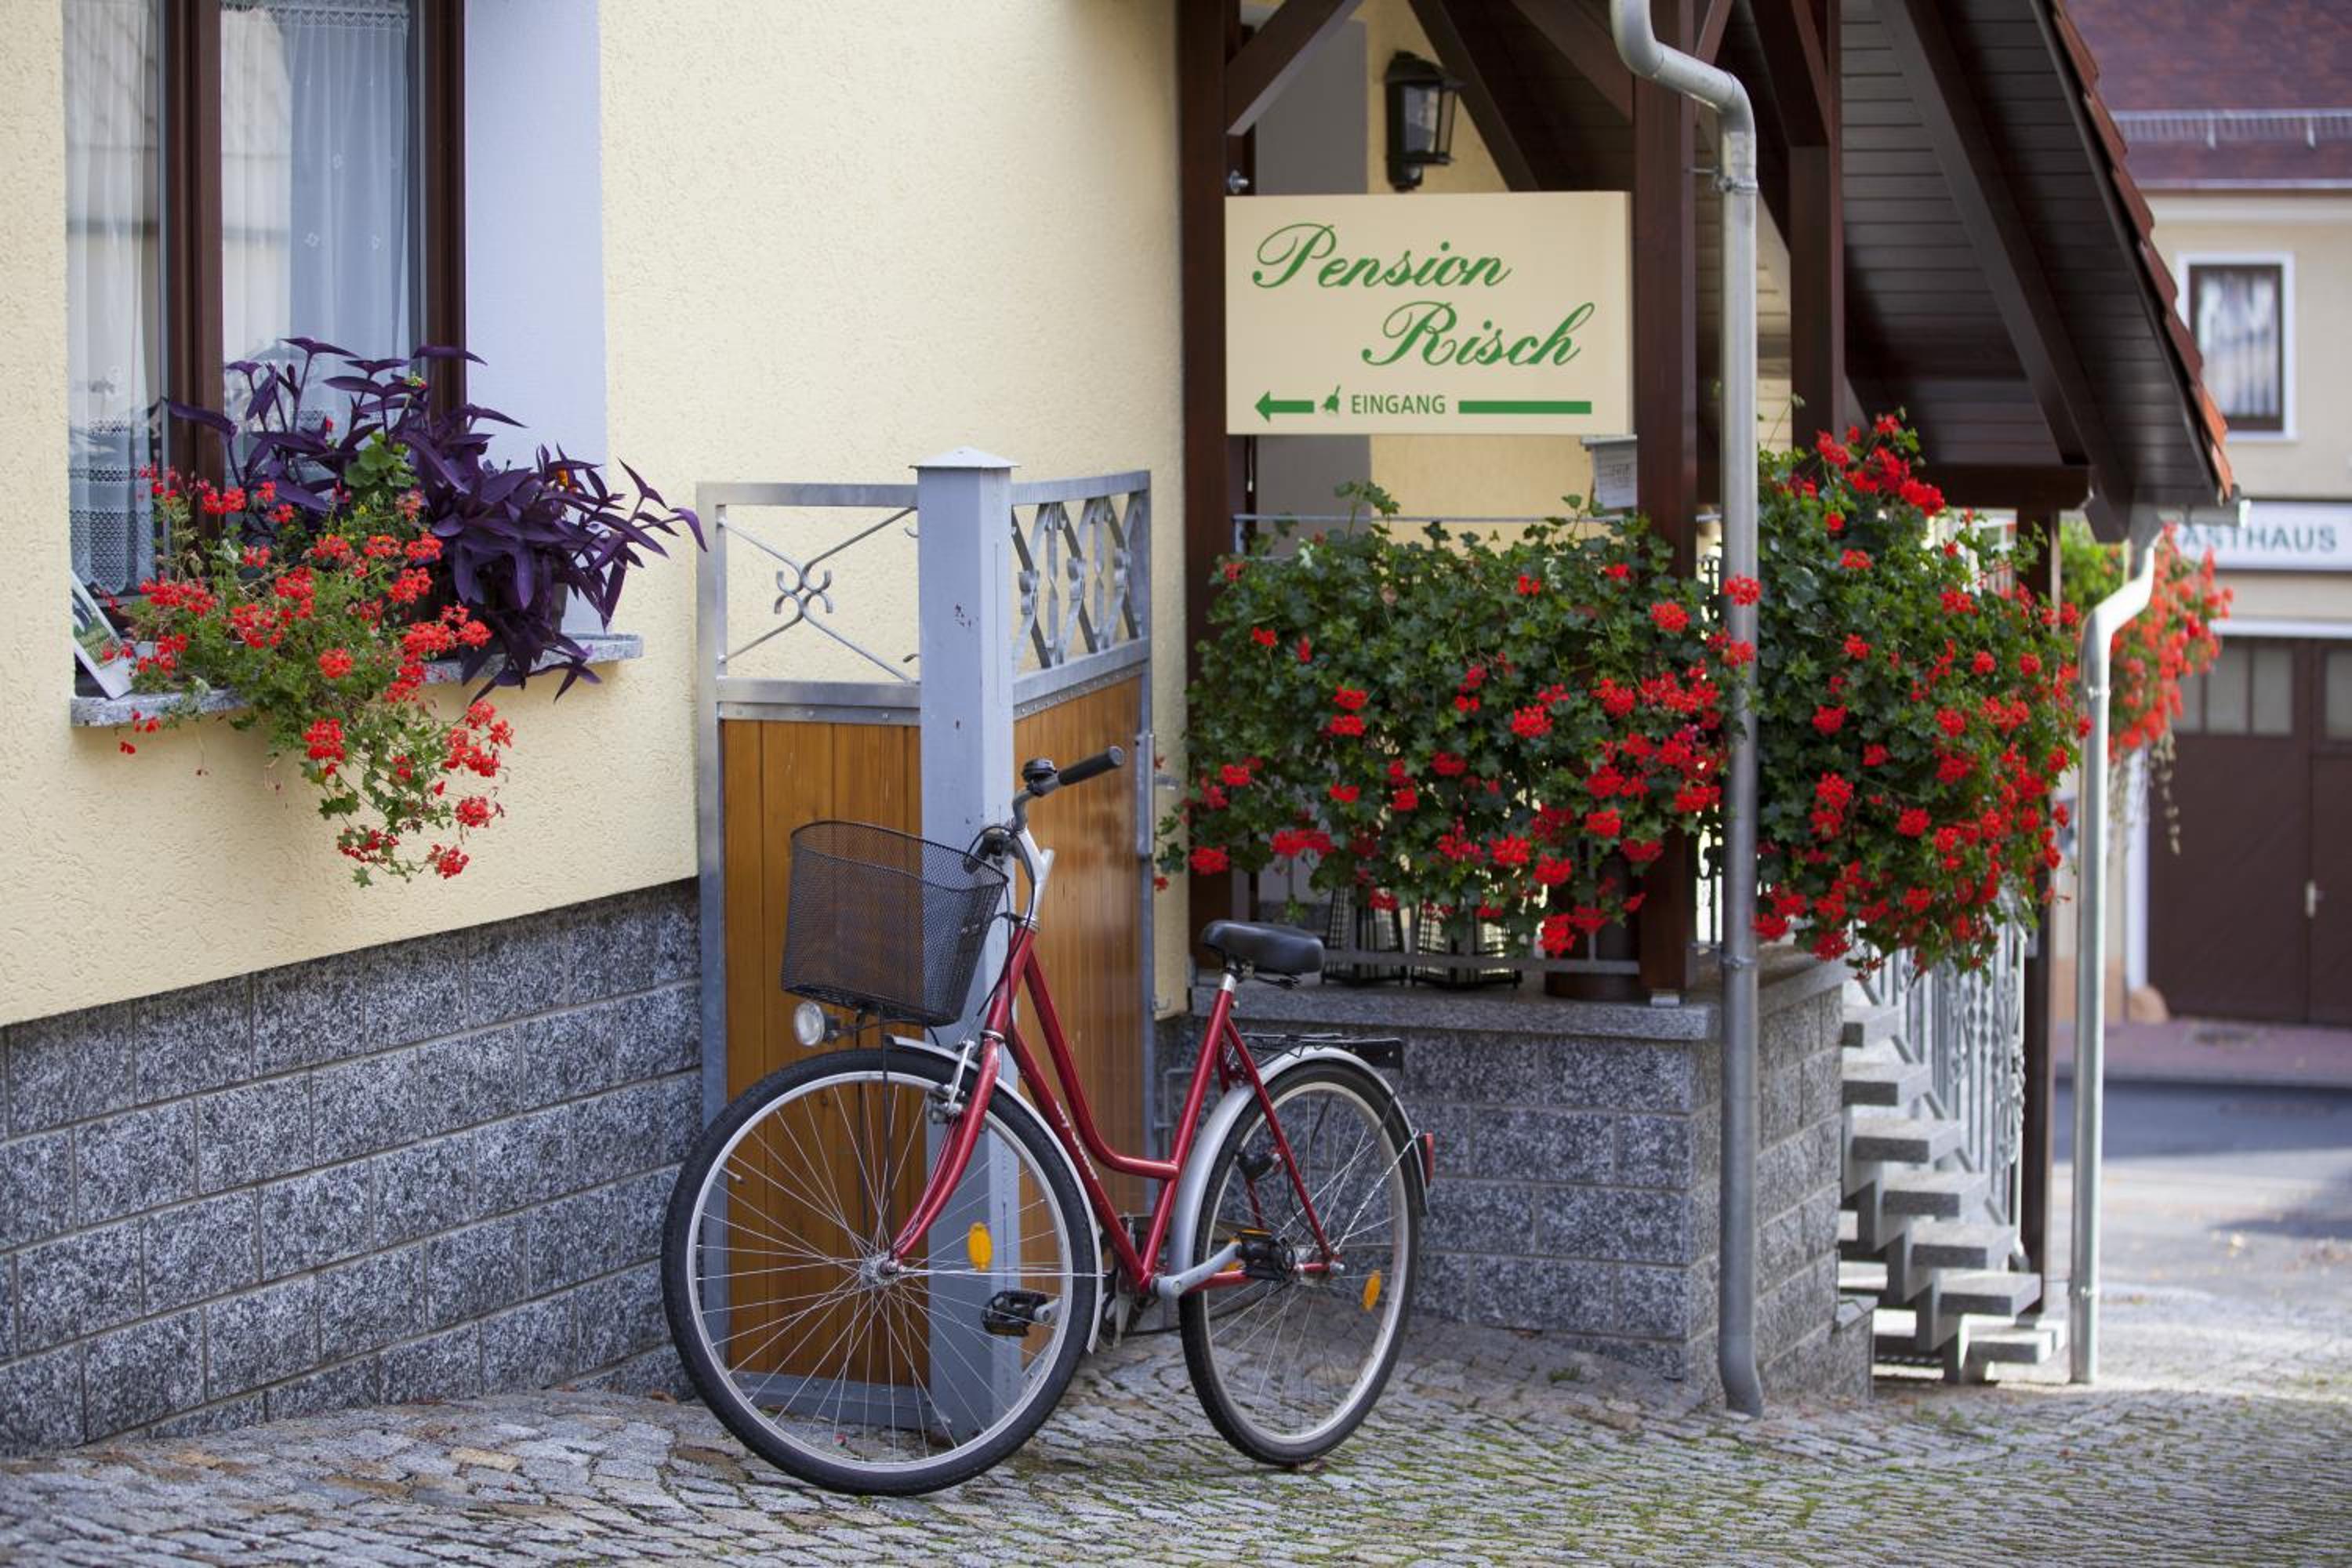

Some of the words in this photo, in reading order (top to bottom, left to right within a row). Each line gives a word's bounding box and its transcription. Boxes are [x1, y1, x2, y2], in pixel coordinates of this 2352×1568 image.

[1252, 223, 1512, 289] Pension
[1361, 300, 1595, 366] Risch
[1350, 394, 1446, 416] EINGANG
[2176, 524, 2337, 553] ASTHAUS
